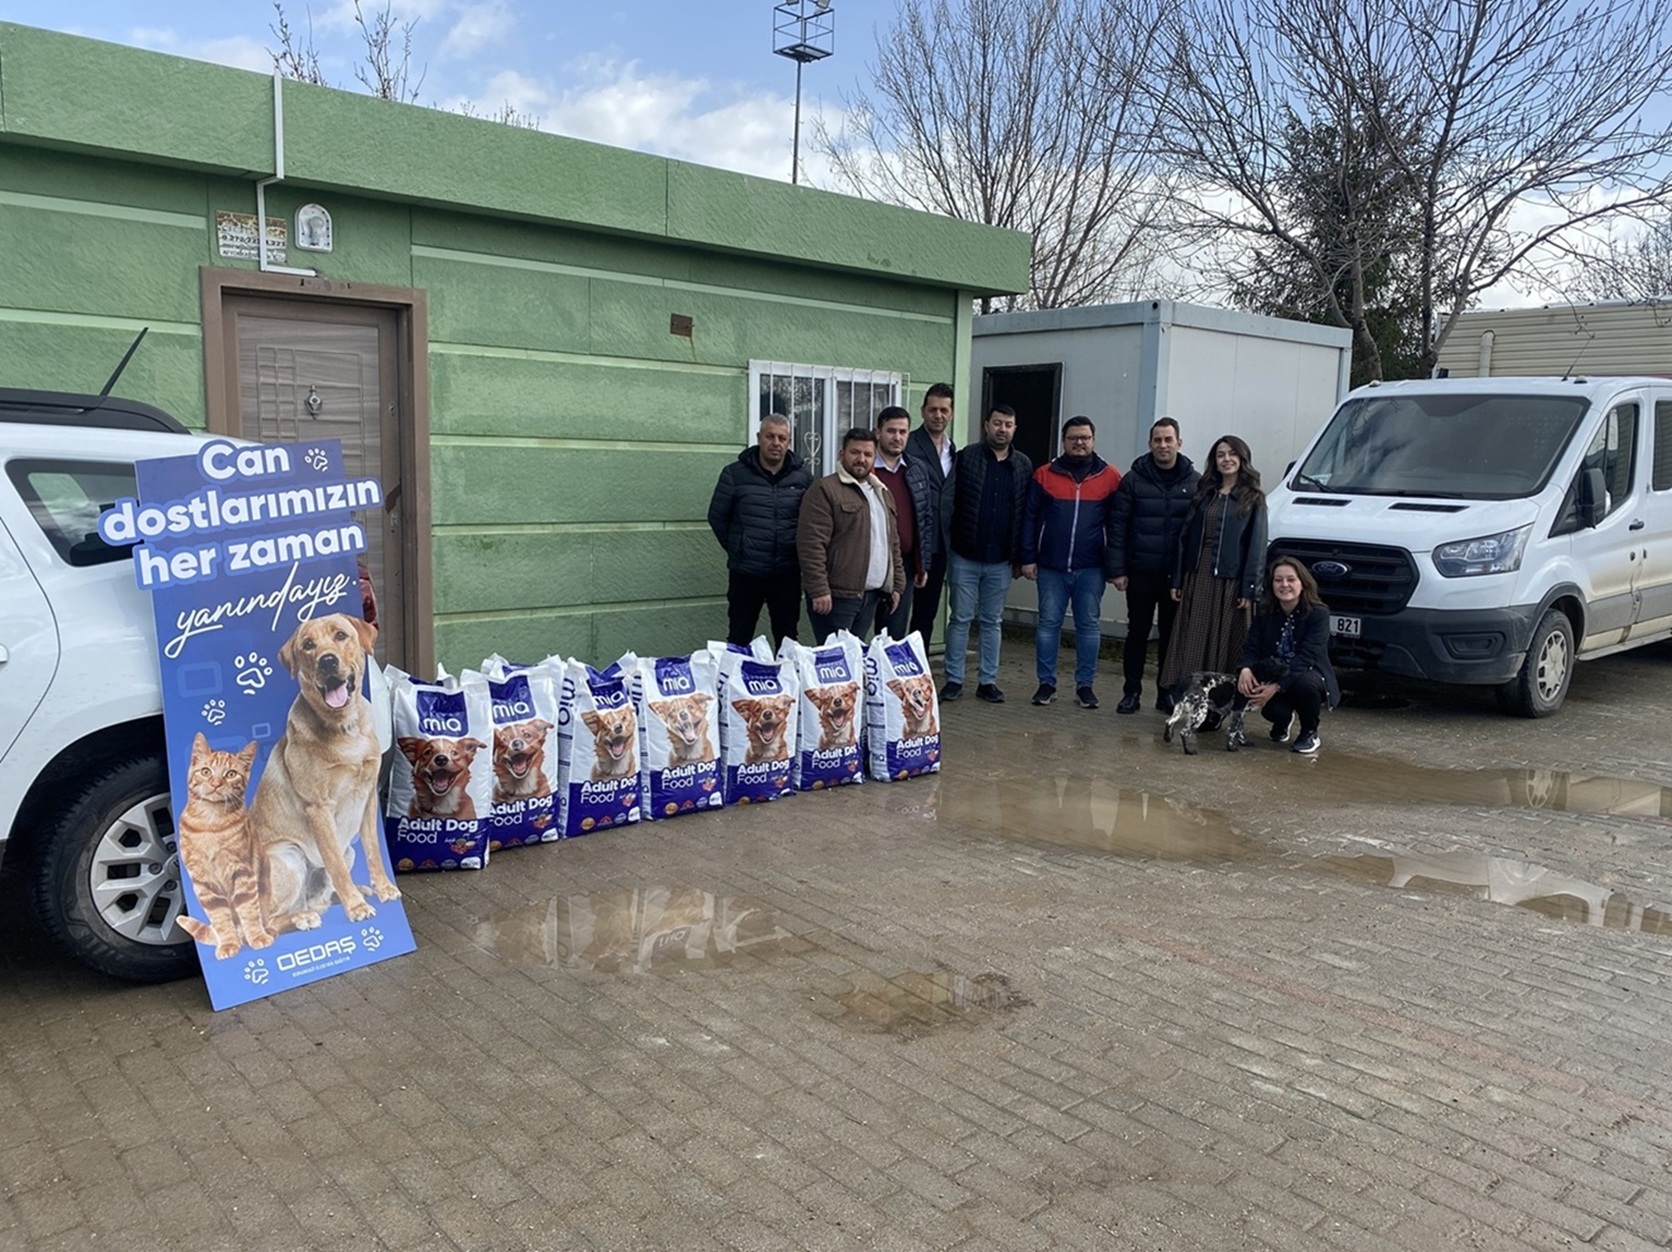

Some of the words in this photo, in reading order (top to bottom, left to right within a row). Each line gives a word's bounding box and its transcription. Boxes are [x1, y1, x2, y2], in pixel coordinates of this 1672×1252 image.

[202, 443, 290, 479] Can
[103, 480, 380, 540] dostlarımızın
[138, 547, 216, 585] her
[228, 525, 364, 571] zaman
[1337, 618, 1359, 633] 821
[820, 666, 847, 679] mia
[894, 661, 919, 673] mia
[663, 677, 690, 691] mia
[749, 680, 777, 691] mia
[592, 690, 625, 706] mia
[493, 702, 530, 718] mia
[423, 718, 461, 731] mia
[896, 737, 923, 749] Adult
[812, 748, 843, 760] Adult
[896, 747, 921, 759] Food
[661, 765, 696, 779] Adult
[697, 761, 716, 773] Dog
[737, 763, 770, 775] Adult
[771, 760, 789, 771] Dog
[812, 759, 840, 769] Food
[662, 776, 694, 790] Food
[737, 773, 767, 784] Food
[581, 780, 618, 793] Adult
[529, 795, 553, 810] Dog
[580, 791, 615, 804] Food
[398, 817, 442, 831] Adult
[446, 819, 478, 833] Dog
[489, 812, 523, 826] ood
[397, 829, 437, 844] Food
